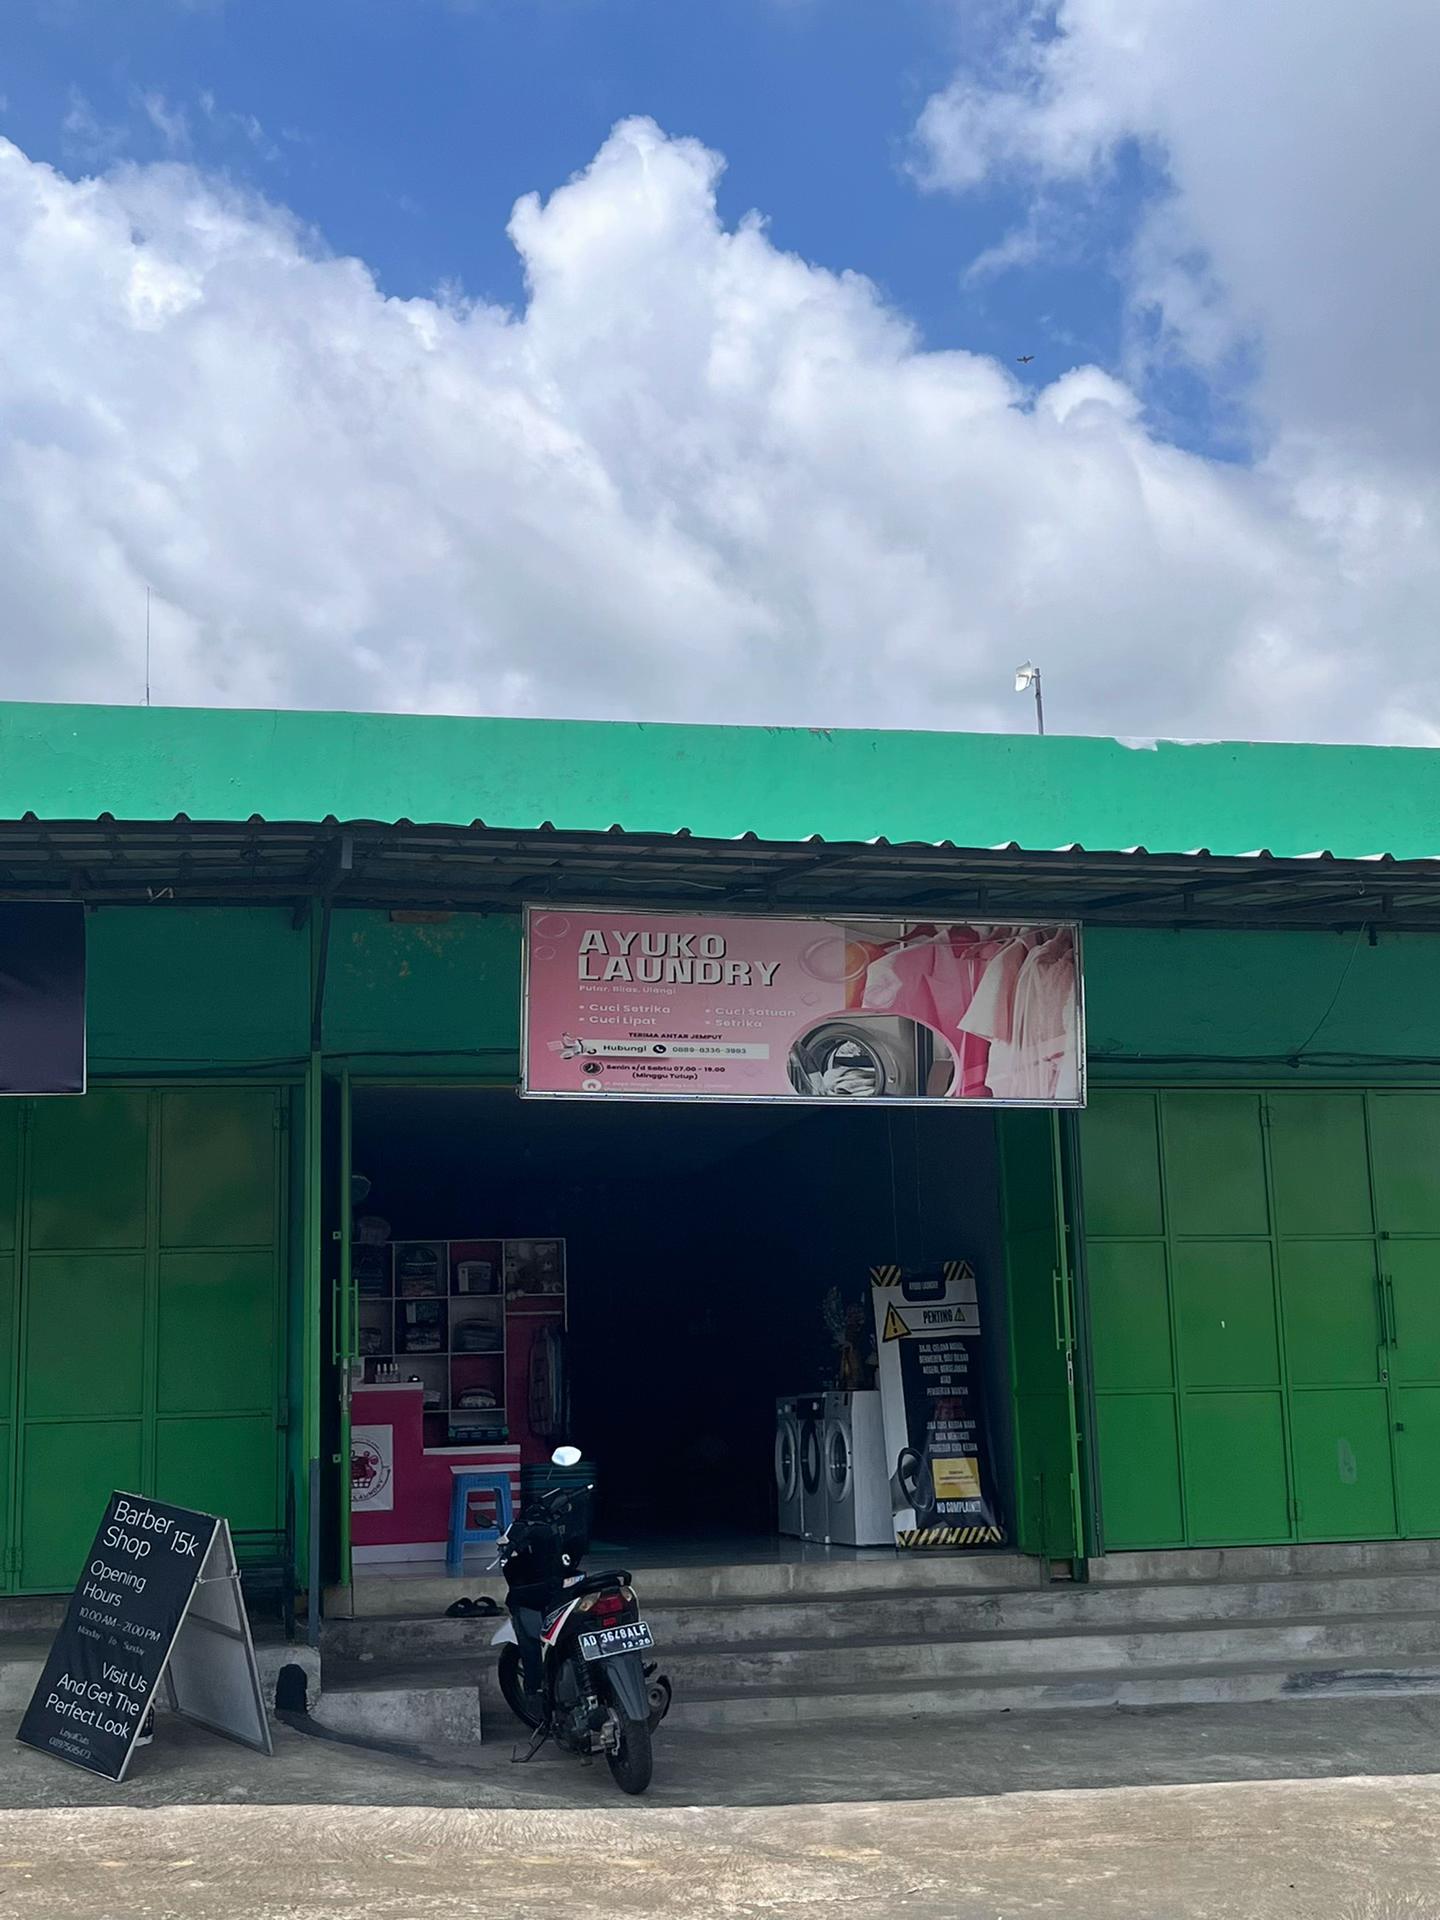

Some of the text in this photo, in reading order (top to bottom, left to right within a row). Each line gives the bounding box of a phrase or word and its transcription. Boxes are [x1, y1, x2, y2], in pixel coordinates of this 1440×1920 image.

[578, 930, 727, 959] AYUKO
[578, 956, 781, 987] LAUNDRY
[589, 1004, 670, 1014] Cuci Setrika
[589, 1015, 656, 1026] Cuci Lipat
[715, 1007, 796, 1017] Cuci Satuan
[715, 1019, 762, 1028] Setrika
[603, 1044, 647, 1055] Hubungi
[923, 1309, 953, 1324] PENTING
[113, 1500, 174, 1534] Barber
[103, 1526, 151, 1560] Shop
[169, 1529, 199, 1558] 15k
[90, 1560, 147, 1594] Opening
[83, 1581, 122, 1607] Hours
[101, 1615, 117, 1628] AM
[145, 1629, 161, 1642] PM
[583, 1635, 598, 1648] AD
[102, 1662, 148, 1693] Visit Us
[57, 1673, 140, 1716] And Get The
[46, 1693, 131, 1739] Perfect Look
